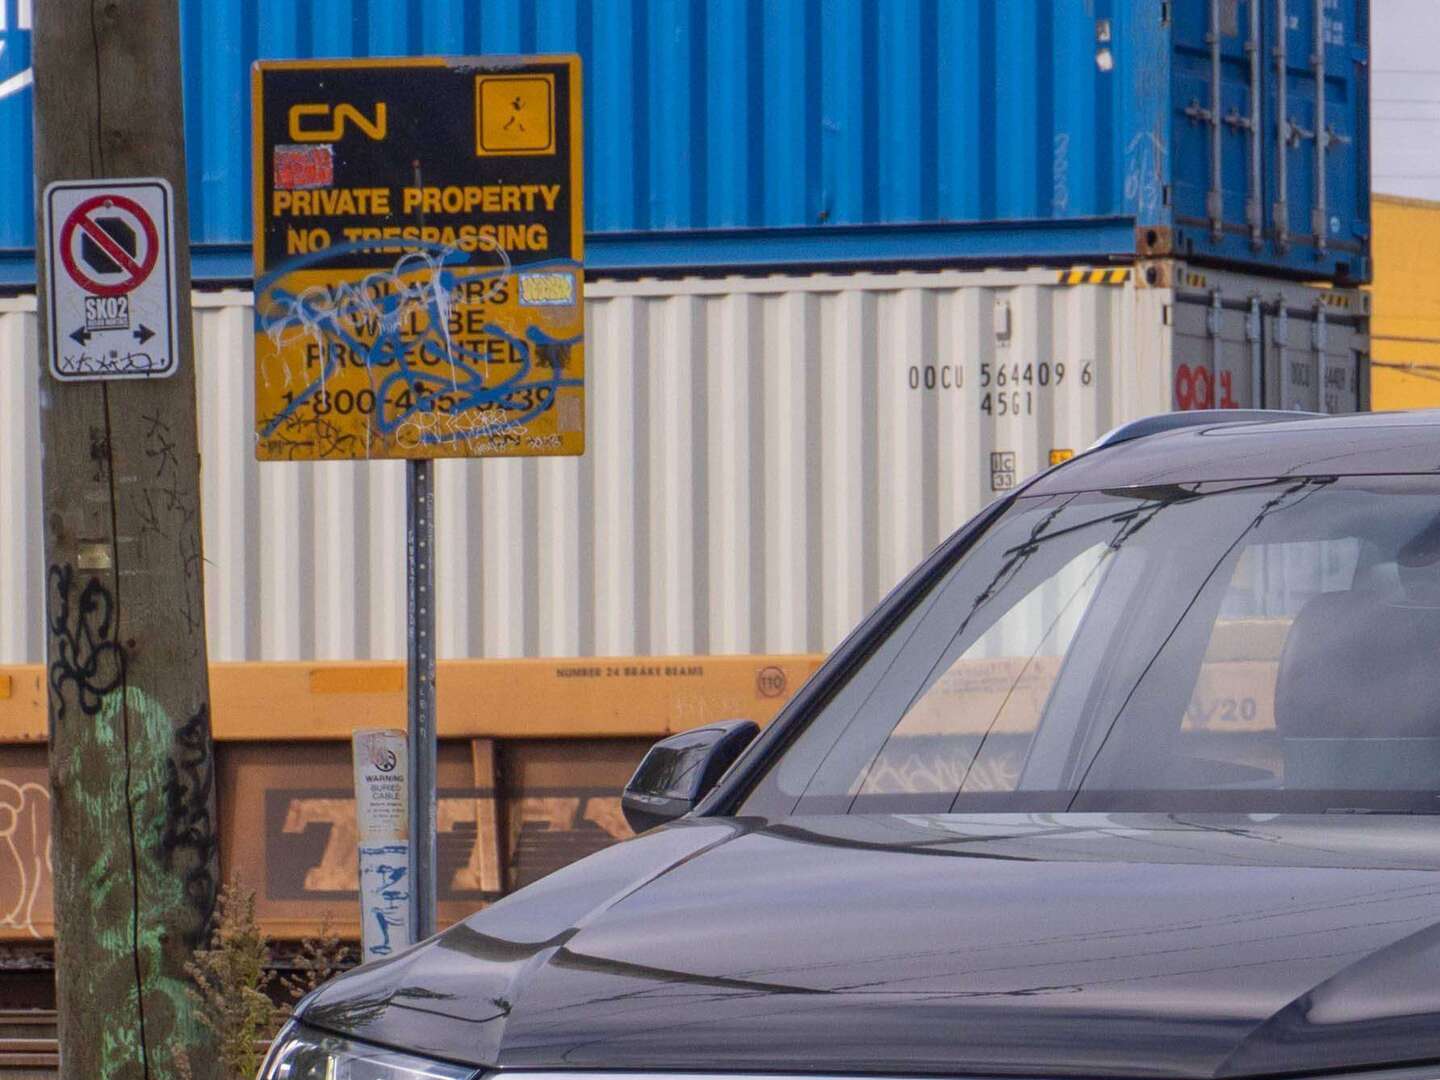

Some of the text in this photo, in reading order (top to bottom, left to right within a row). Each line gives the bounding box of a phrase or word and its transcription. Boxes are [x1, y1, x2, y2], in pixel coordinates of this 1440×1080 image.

[288, 102, 387, 142] CN
[272, 185, 561, 216] PRIVATE PROPERTY
[287, 223, 549, 255] NO TRESPASSING
[980, 362, 1065, 388] 564409
[1081, 361, 1092, 386] 6
[980, 392, 1032, 416] 45G1
[556, 667, 601, 677] NUMBER
[366, 775, 405, 783] WARNING
